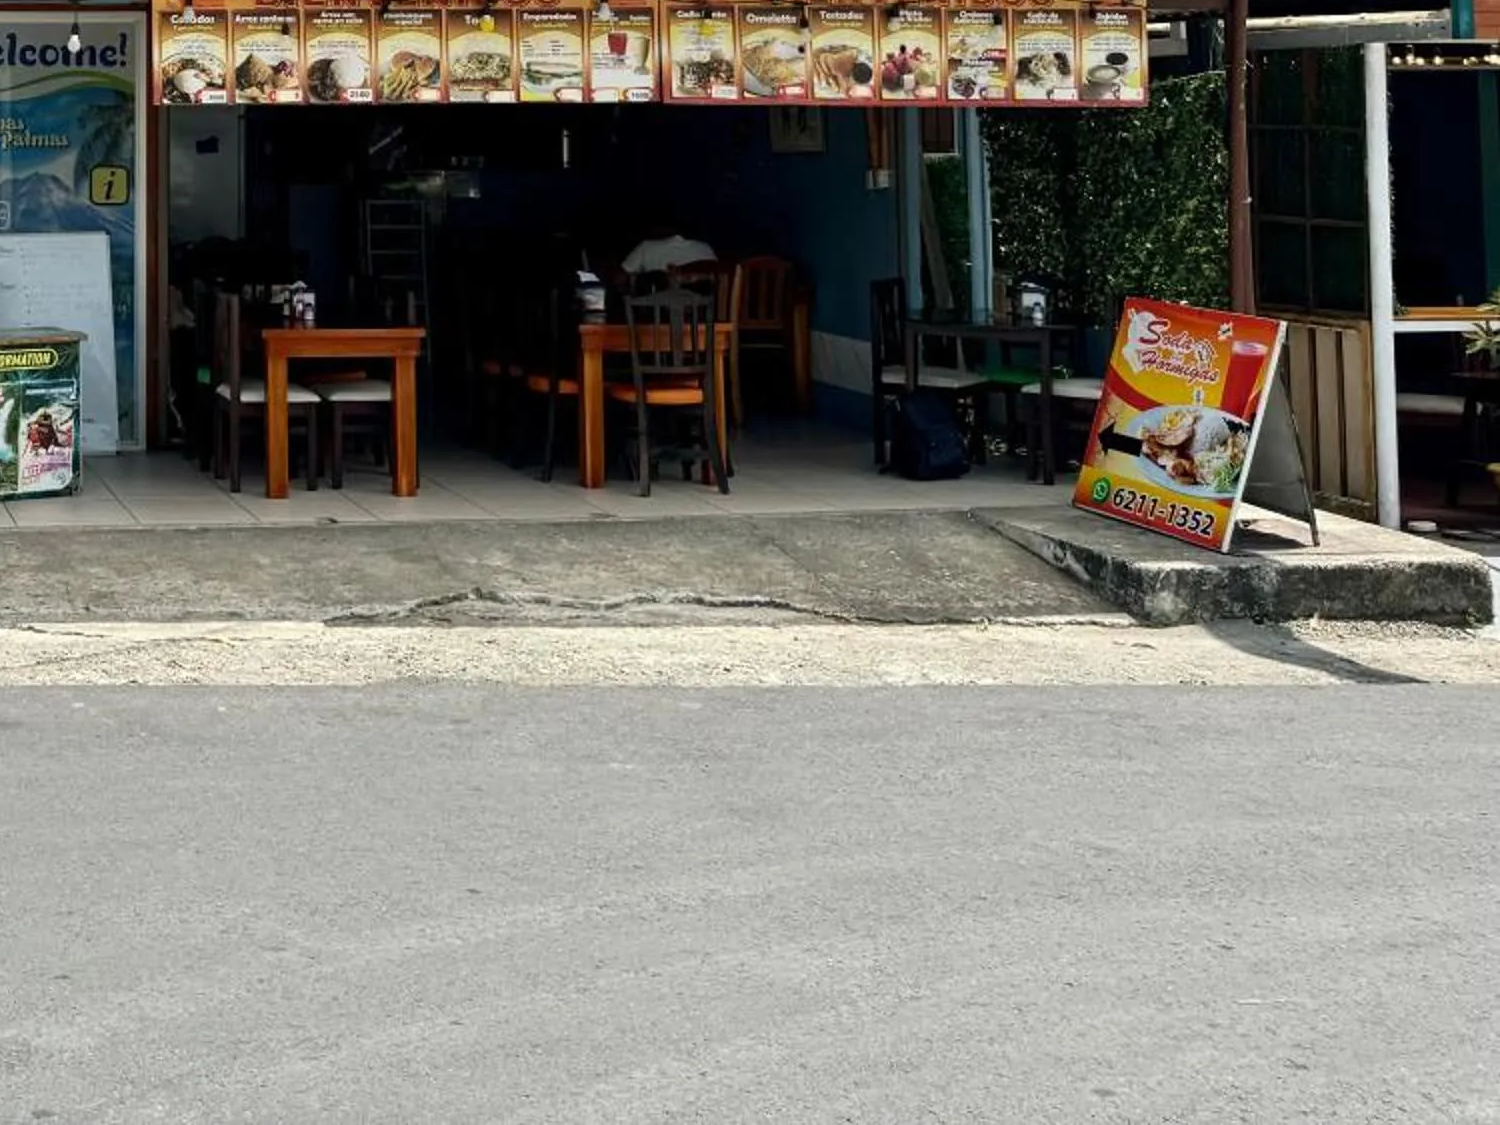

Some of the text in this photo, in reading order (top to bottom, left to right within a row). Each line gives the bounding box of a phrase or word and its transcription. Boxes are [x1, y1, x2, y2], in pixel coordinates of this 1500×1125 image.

[1138, 318, 1195, 354] Soda
[1140, 350, 1221, 385] Hormigas
[1112, 486, 1216, 537] 6211-1352
